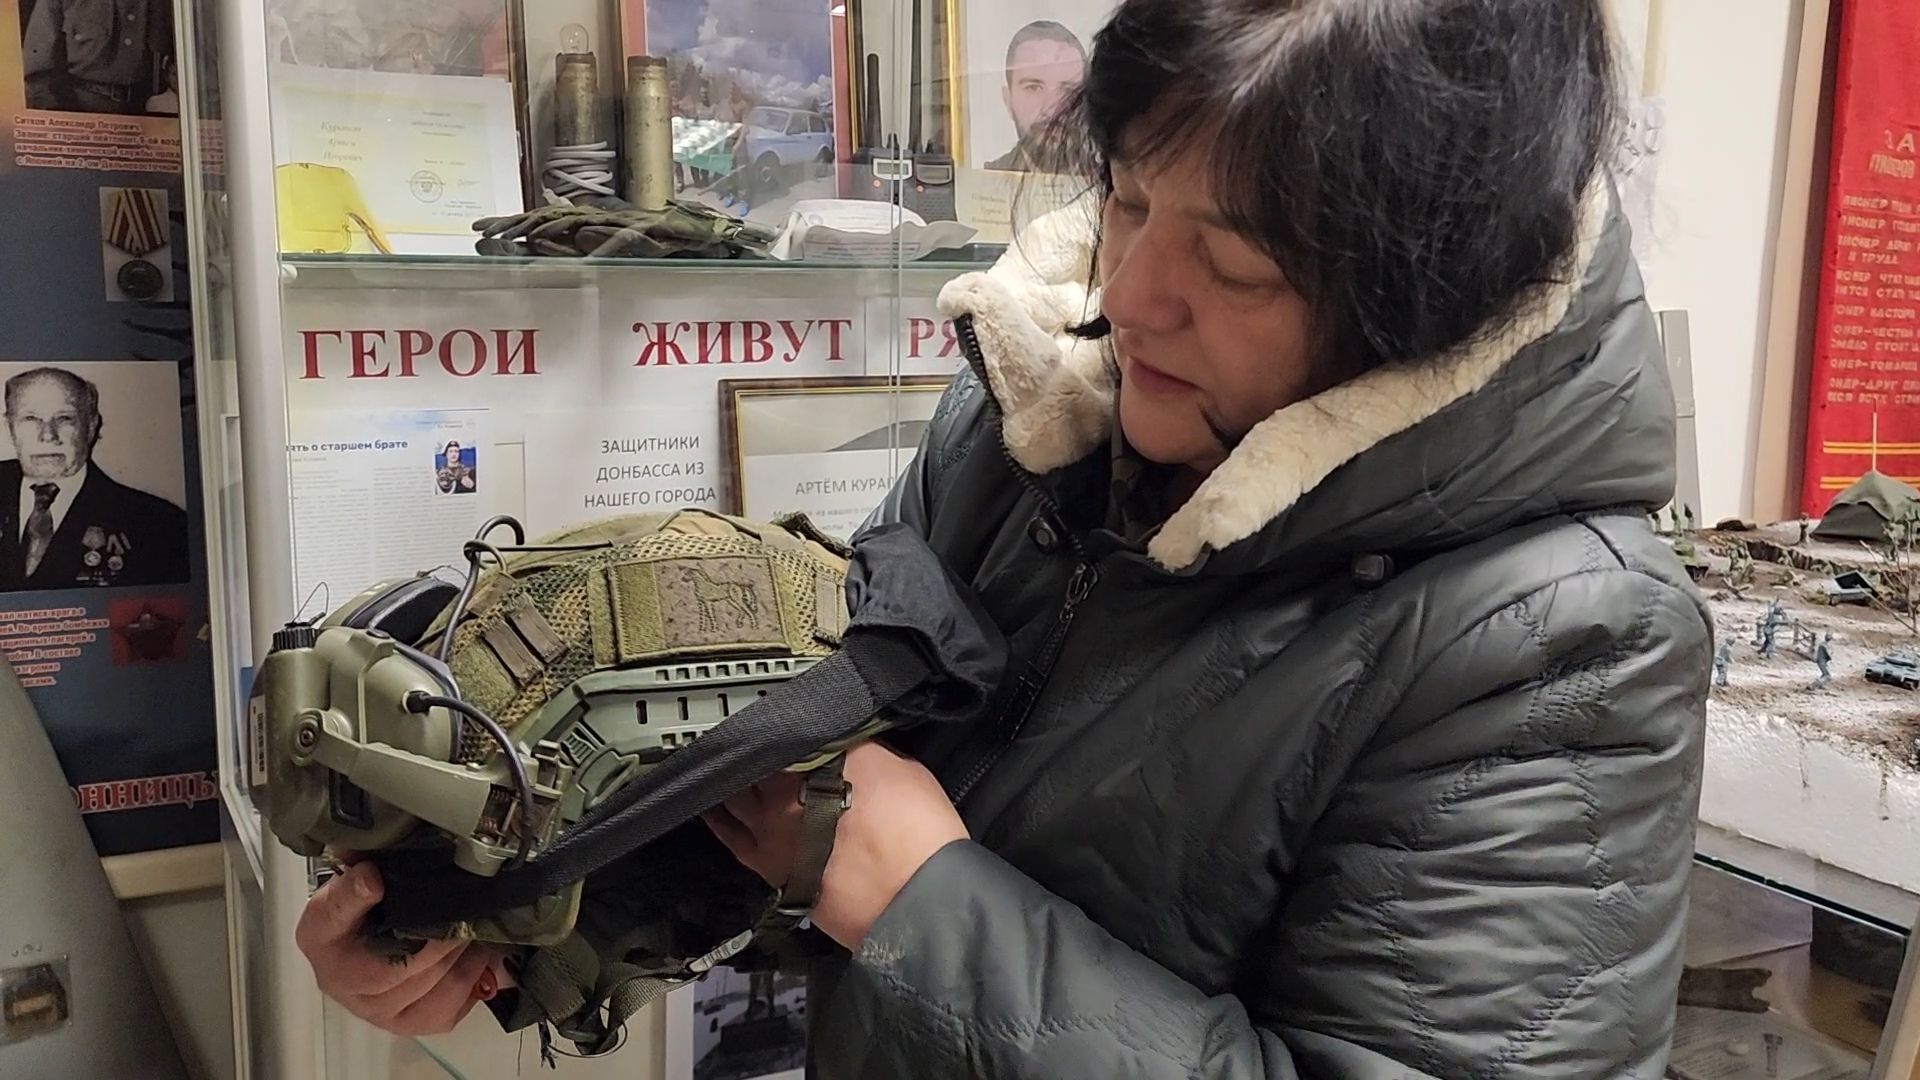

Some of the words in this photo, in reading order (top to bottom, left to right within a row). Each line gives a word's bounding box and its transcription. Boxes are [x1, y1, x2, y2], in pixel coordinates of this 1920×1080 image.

[48, 118, 95, 129] Александр
[98, 120, 140, 131] Петрович
[52, 132, 90, 141] старший
[299, 328, 540, 378] ГЕРОИ
[632, 318, 852, 367] ЖИВУТ
[321, 441, 372, 453] старшем
[374, 439, 408, 452] брате
[601, 436, 700, 454] ЗАЩИТНИКИ
[596, 463, 681, 483] ДОНБАССА
[685, 461, 705, 475] ИЗ
[795, 478, 847, 496] АРТЁМ
[584, 491, 650, 508] НАШЕГО
[655, 487, 717, 504] ГОРОДА
